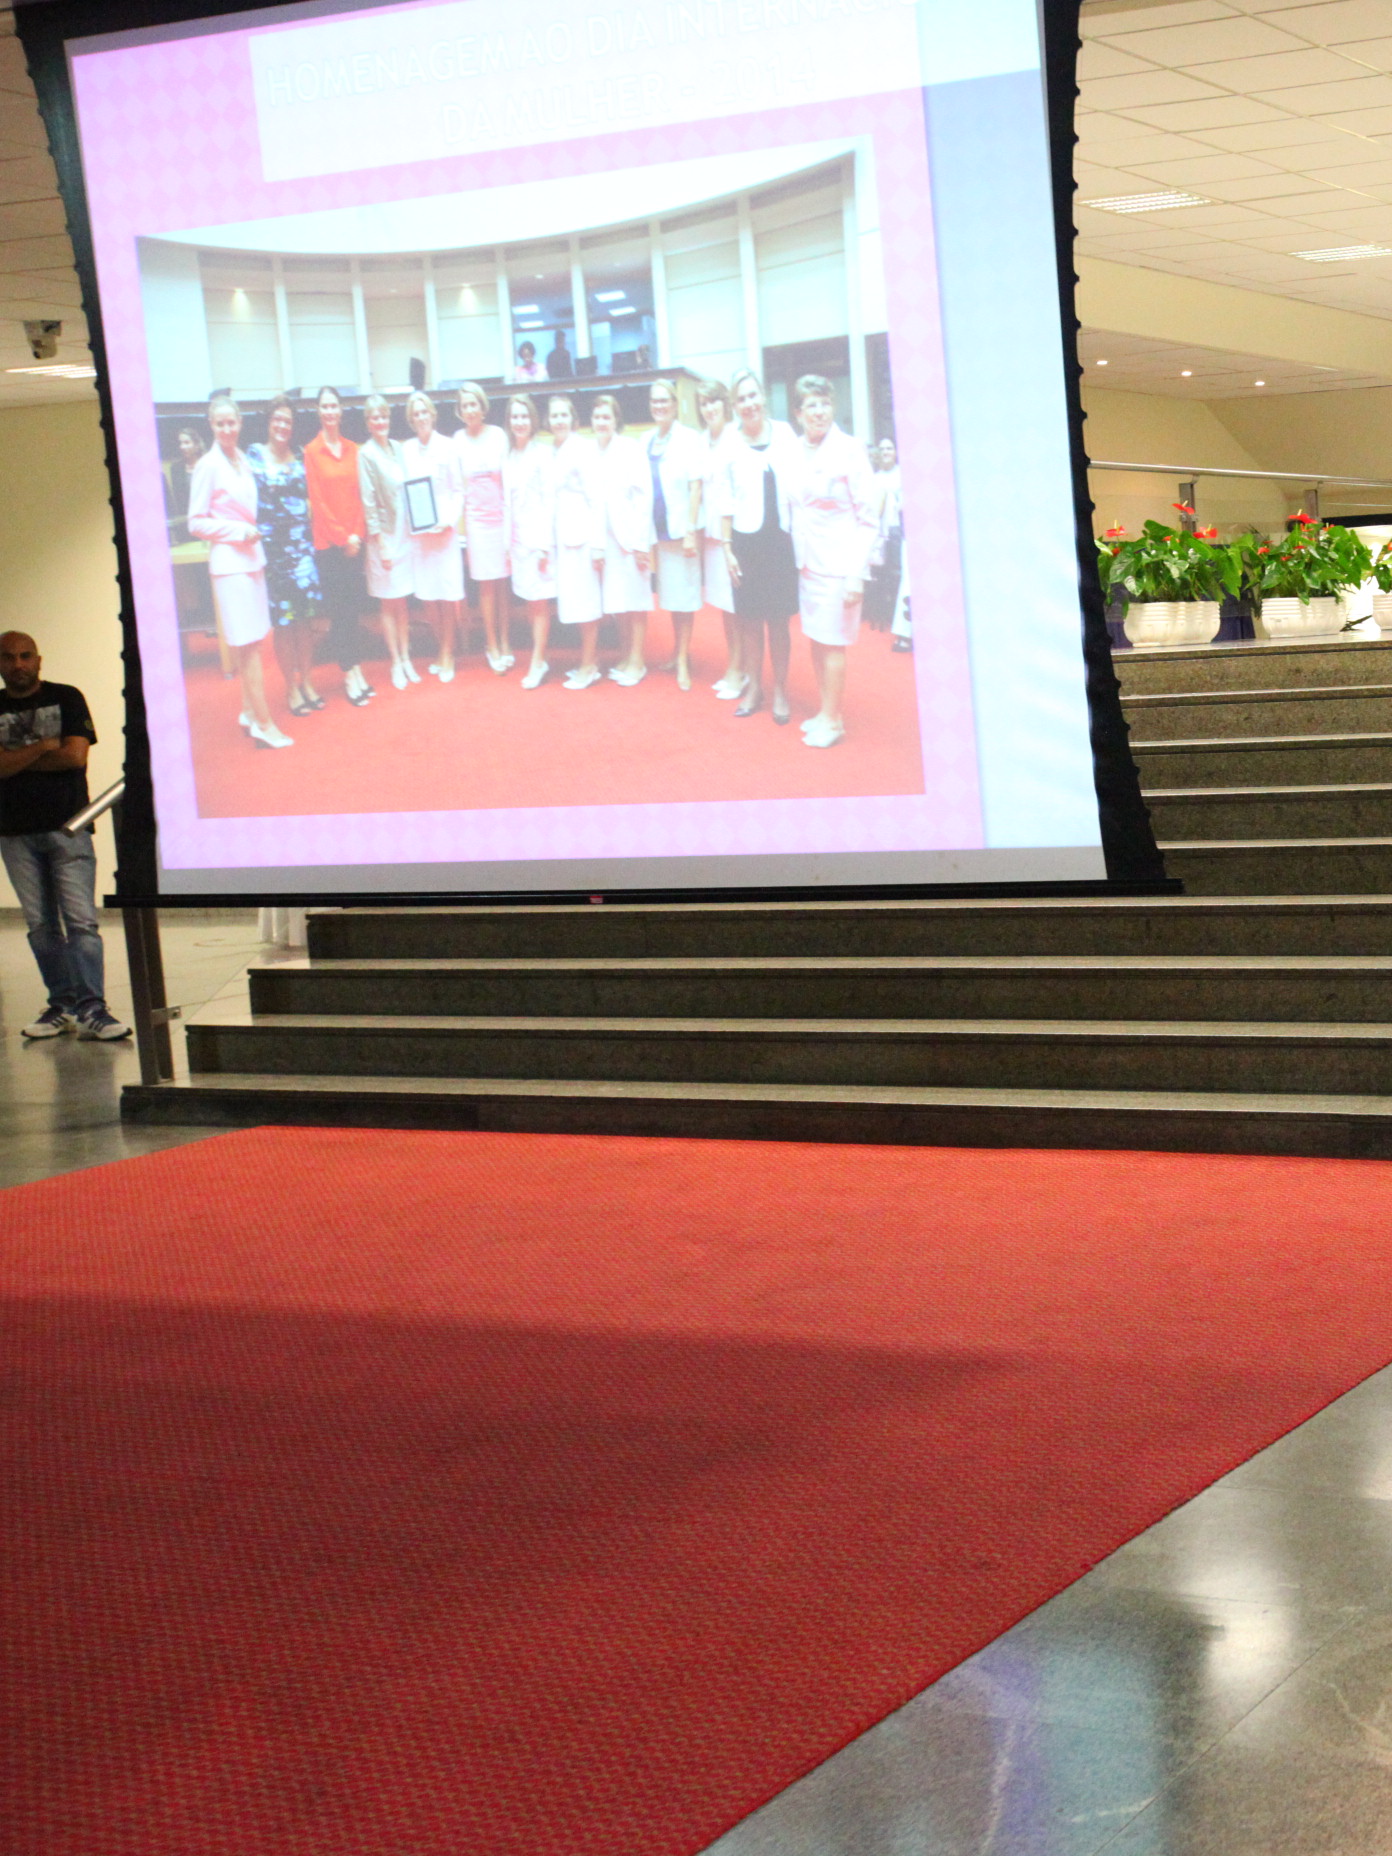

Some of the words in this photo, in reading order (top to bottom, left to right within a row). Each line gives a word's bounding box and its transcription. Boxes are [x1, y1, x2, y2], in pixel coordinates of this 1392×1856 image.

[266, 31, 513, 109] HOMENAGEM
[519, 20, 573, 68] AO
[586, 9, 655, 57] DIA
[664, 0, 917, 44] INTERN
[441, 102, 497, 146] DA
[504, 72, 672, 137] MULHER
[710, 47, 818, 106] 2014
